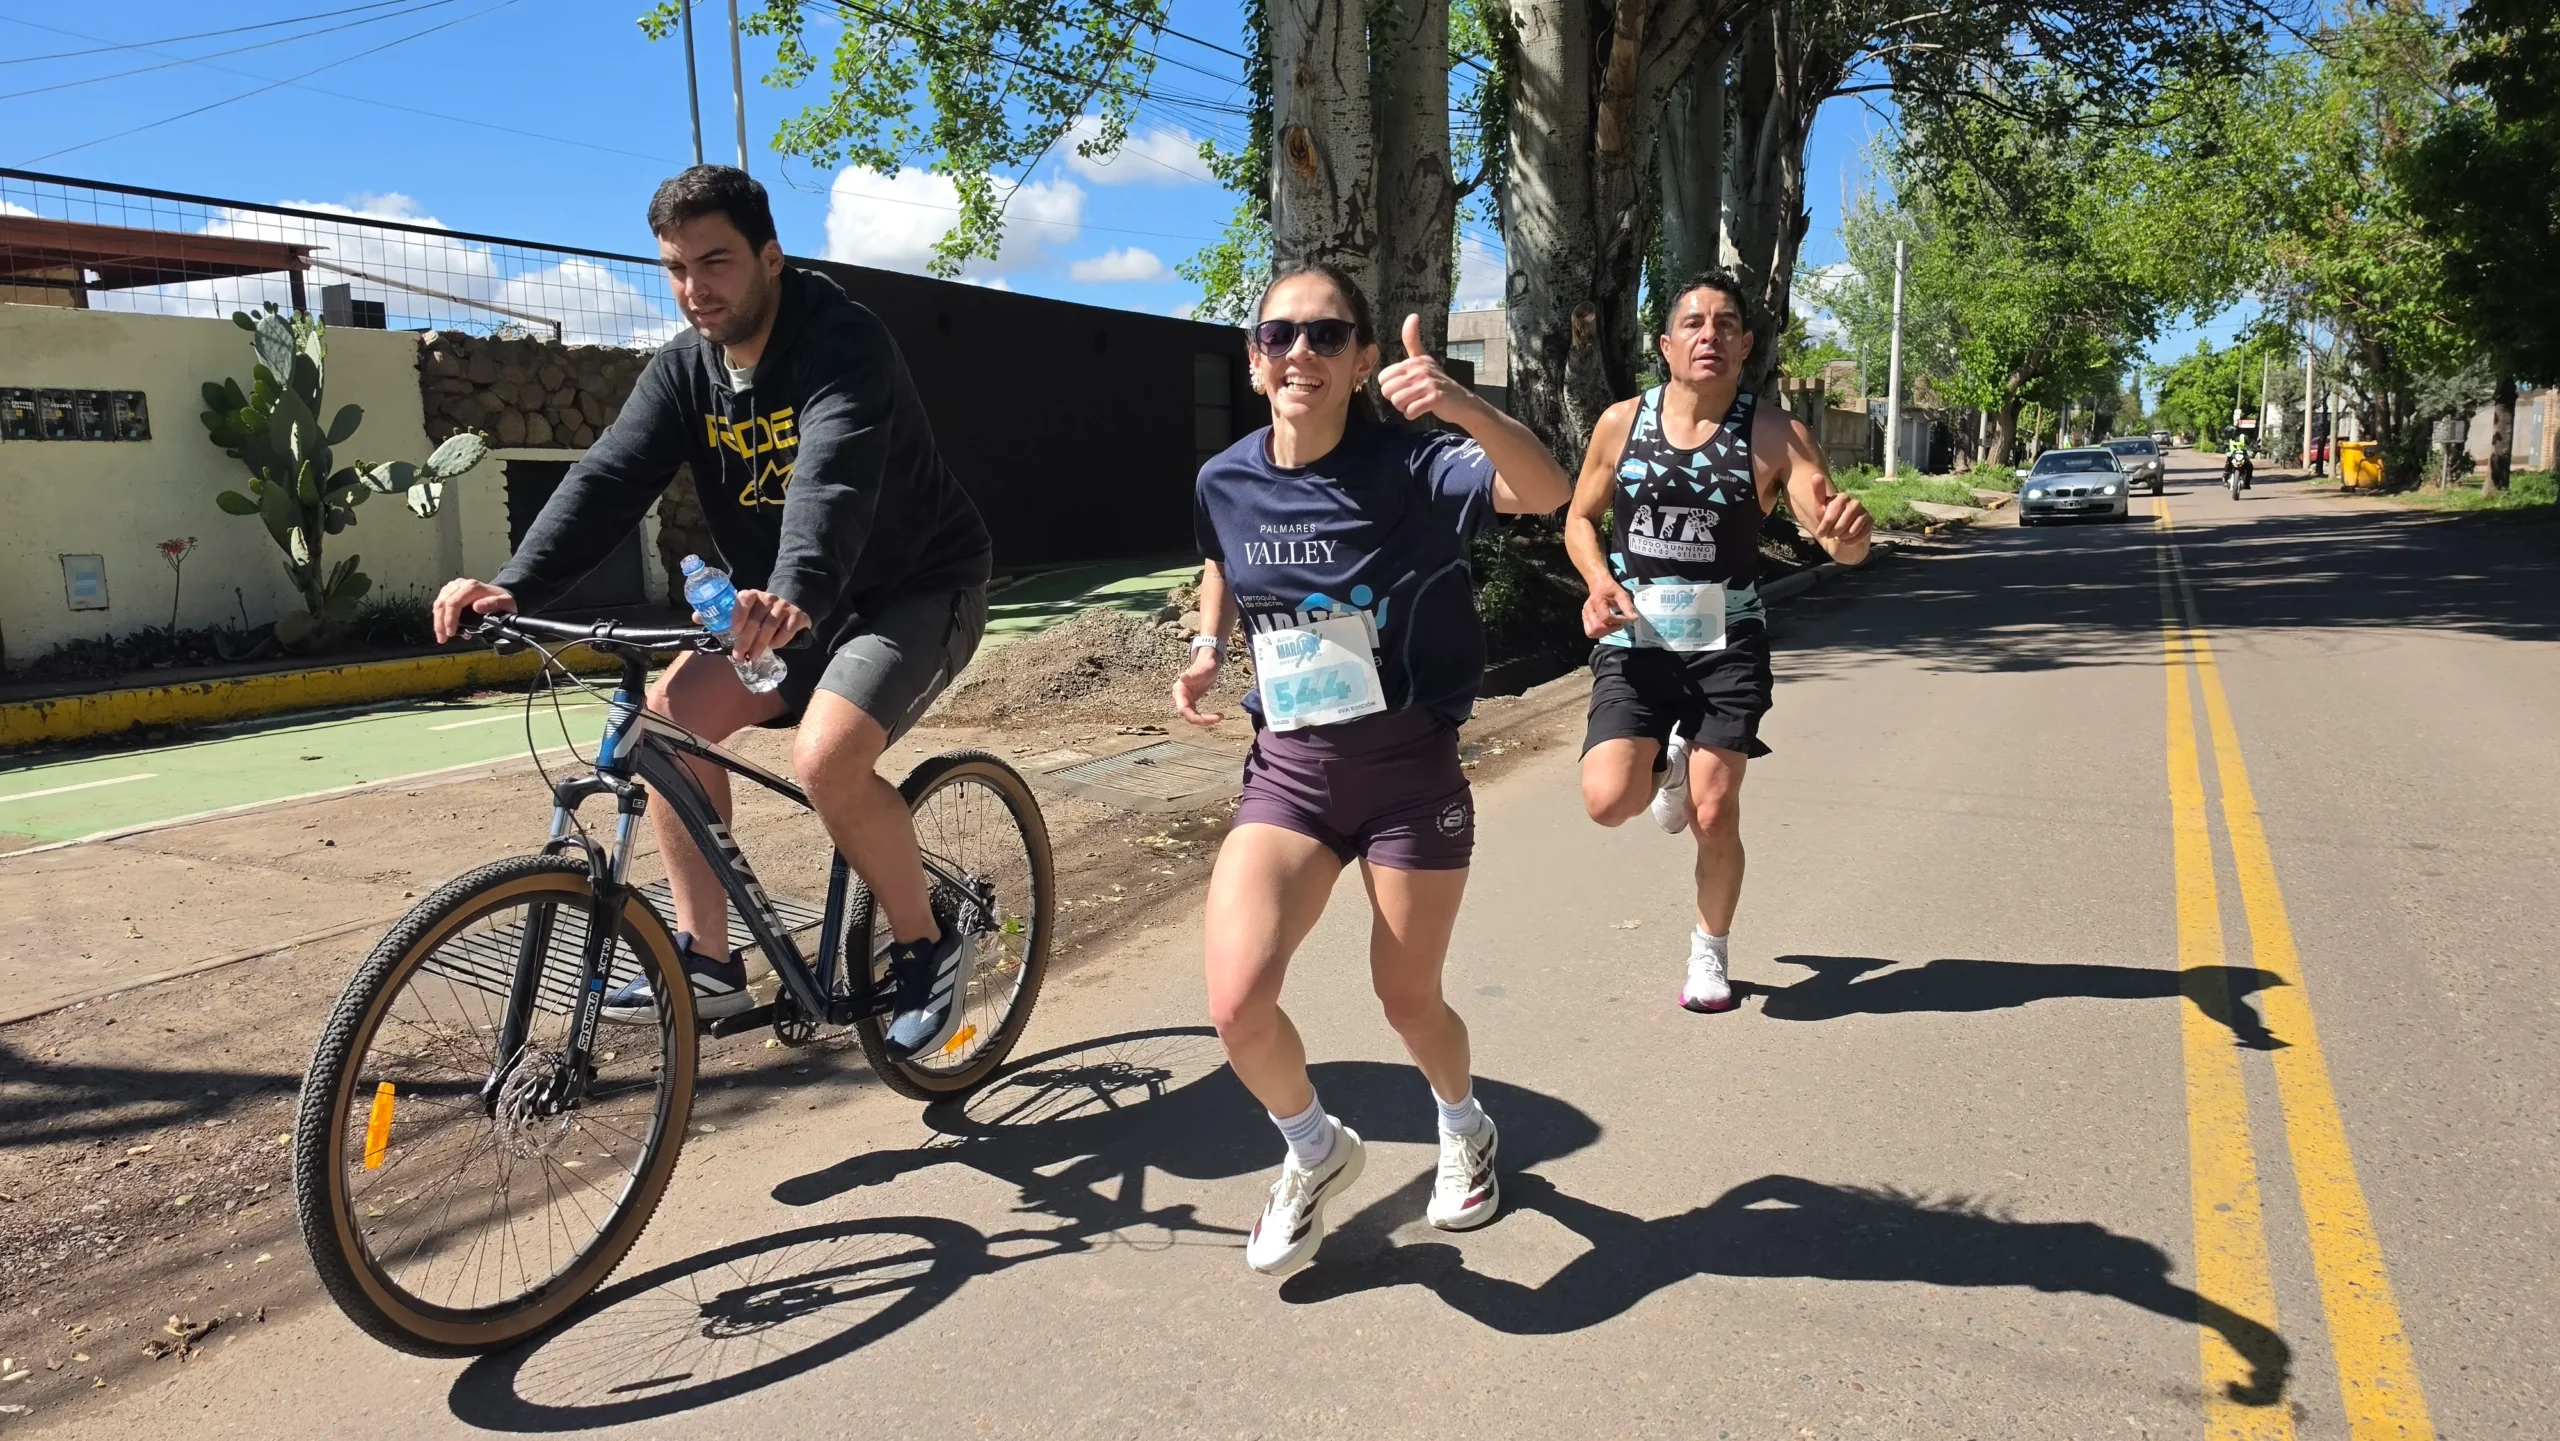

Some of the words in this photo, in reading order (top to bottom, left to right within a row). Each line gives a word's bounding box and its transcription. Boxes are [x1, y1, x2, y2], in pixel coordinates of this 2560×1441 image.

[1259, 523, 1316, 534] PALMARES
[1628, 504, 1721, 542] ATR
[1244, 539, 1338, 566] VALLEY
[1631, 543, 1670, 556] formando
[1676, 550, 1713, 561] atletas
[1638, 539, 1661, 548] TODO
[1663, 543, 1710, 553] RUNNING
[1653, 618, 1703, 640] 552
[1273, 669, 1352, 712] 544
[582, 991, 600, 1034] SUNTOUR
